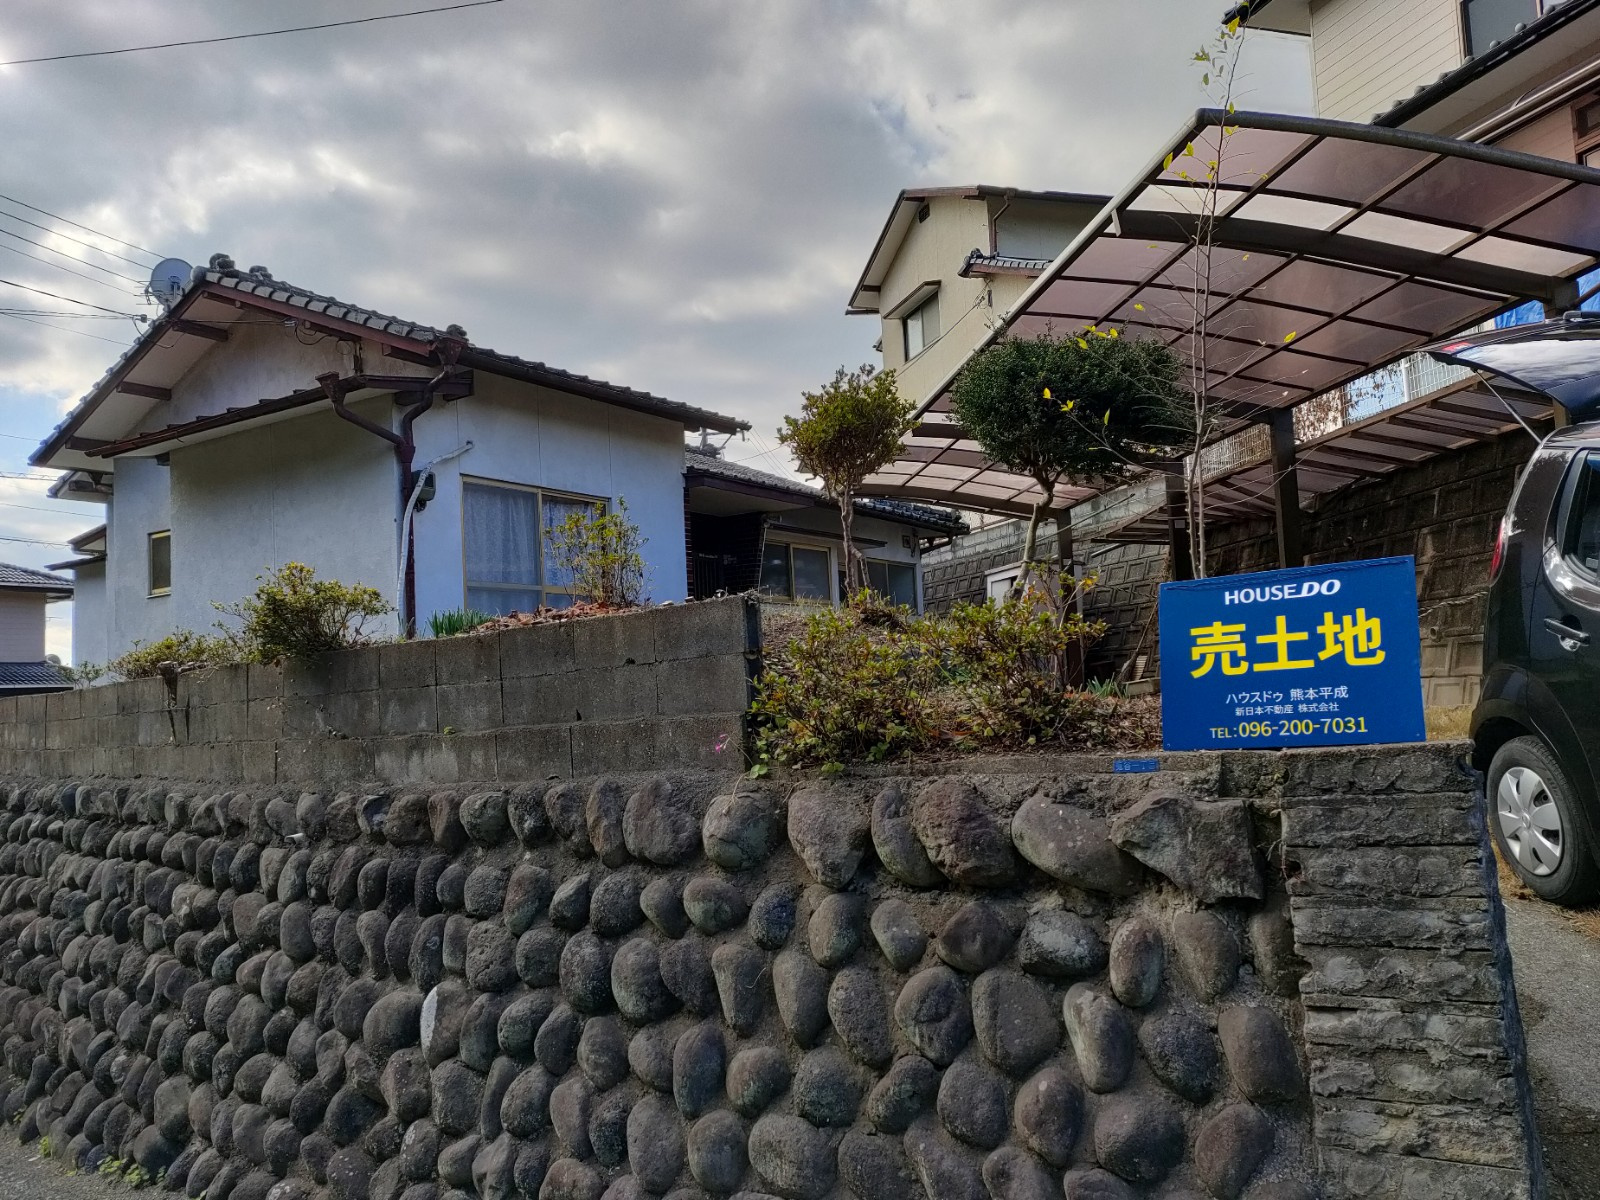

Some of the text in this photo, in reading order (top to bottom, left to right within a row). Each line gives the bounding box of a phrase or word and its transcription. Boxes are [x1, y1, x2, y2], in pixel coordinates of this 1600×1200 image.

[1189, 607, 1386, 679] 売土地
[1225, 685, 1349, 704] ハウスドゥ 熊本平成
[1234, 701, 1340, 717] 新日本不動産 株式会社
